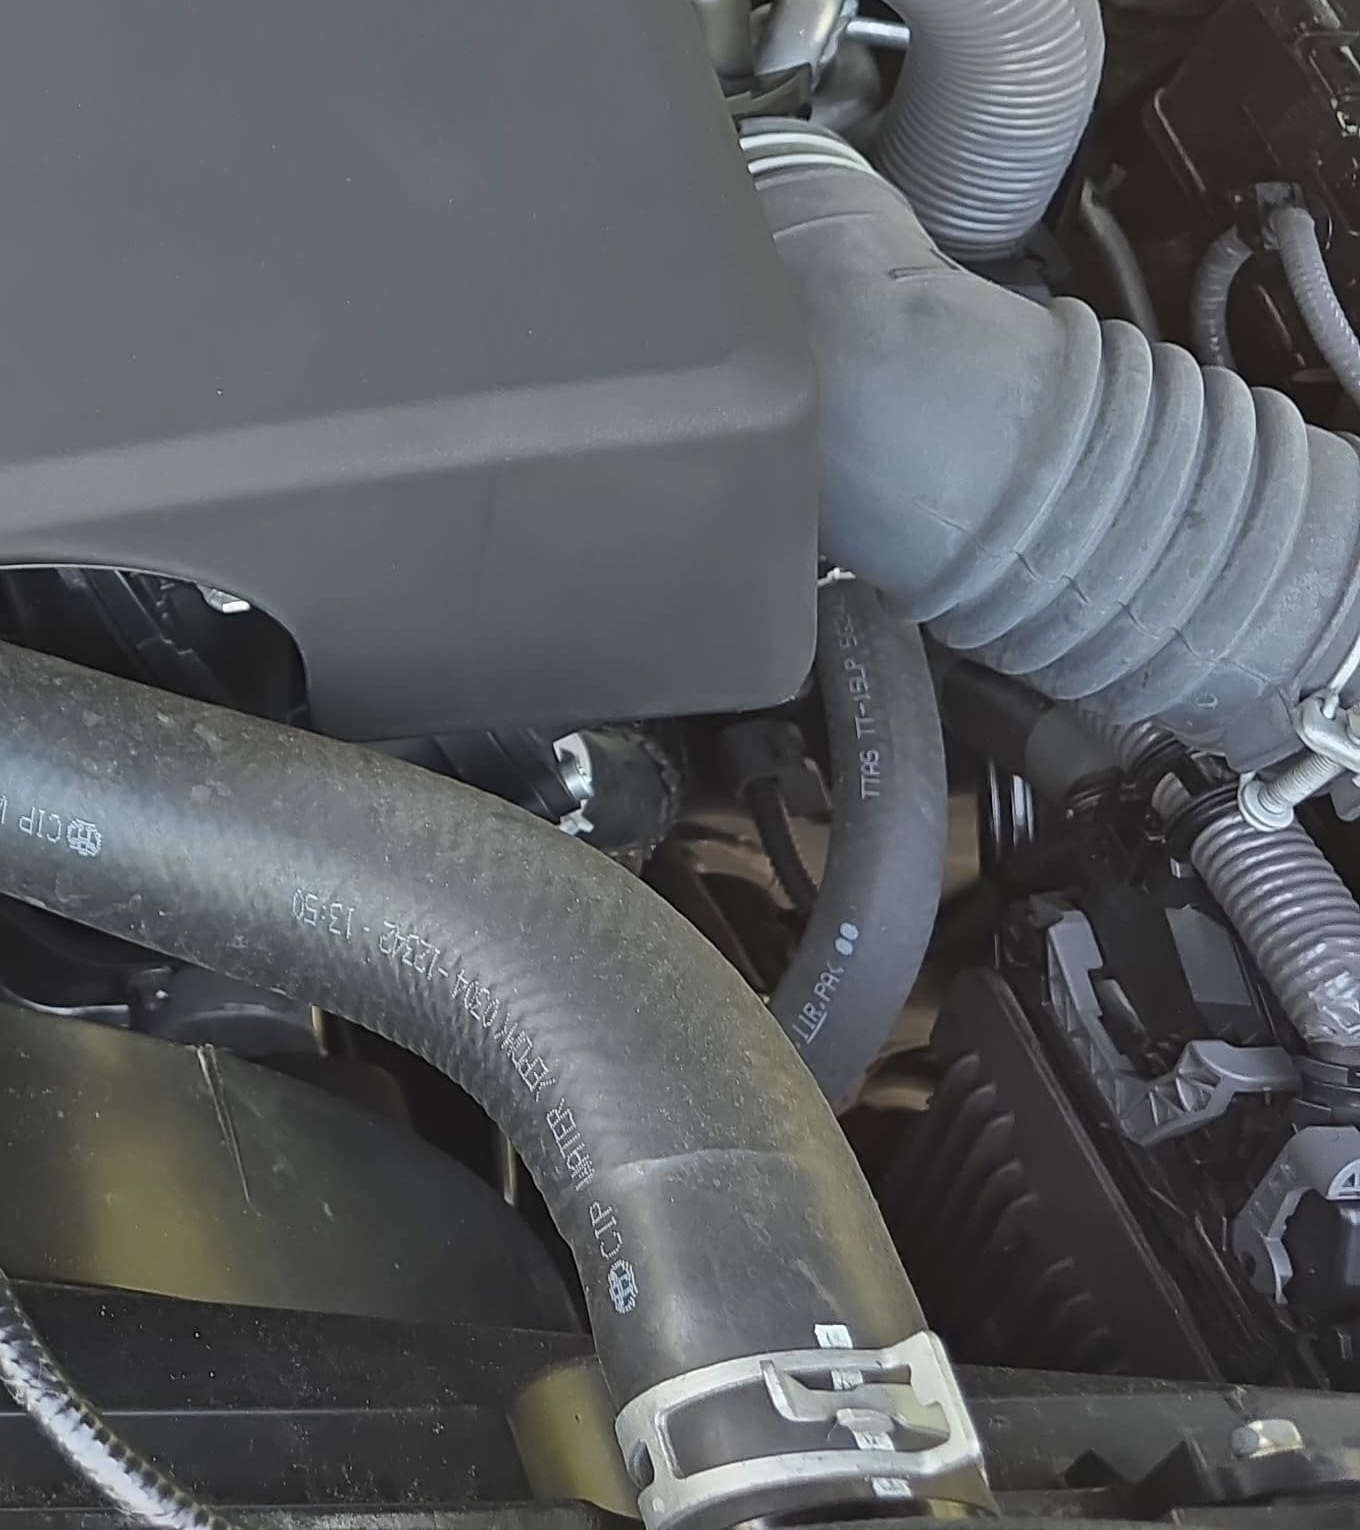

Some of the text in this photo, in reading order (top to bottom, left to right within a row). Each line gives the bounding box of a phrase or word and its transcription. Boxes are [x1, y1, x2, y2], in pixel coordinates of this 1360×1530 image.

[18, 801, 63, 843] CIP
[291, 886, 357, 942] 13:50
[545, 1096, 596, 1192] WATER
[588, 1200, 623, 1259] CIP
